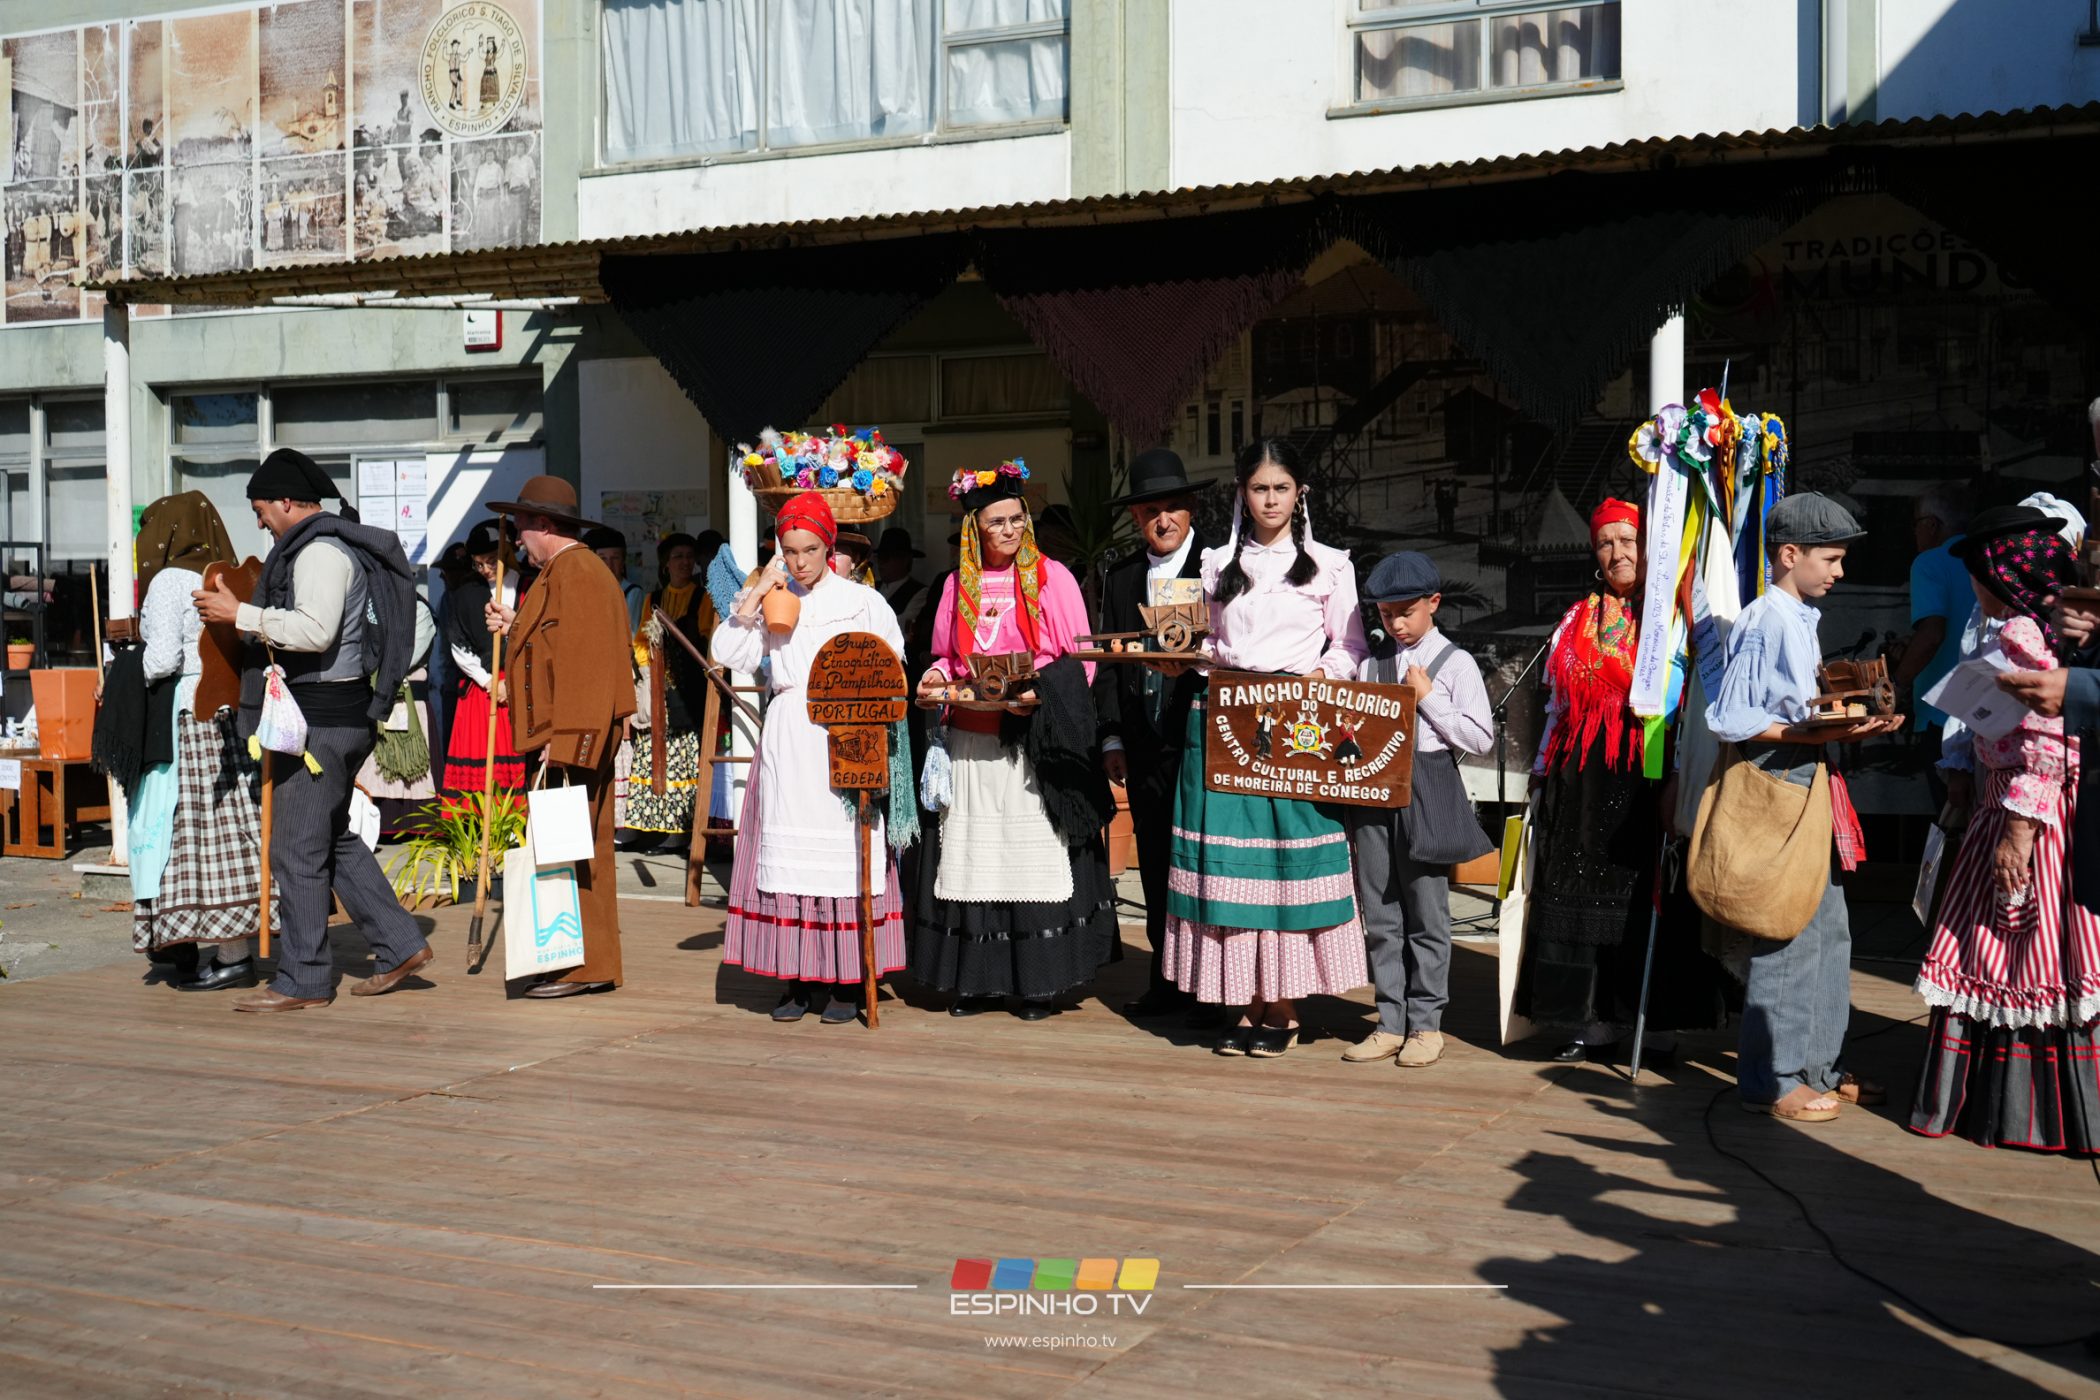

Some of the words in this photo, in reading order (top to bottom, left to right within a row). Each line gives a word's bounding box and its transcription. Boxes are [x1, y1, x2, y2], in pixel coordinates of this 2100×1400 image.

[480, 6, 488, 17] S.
[491, 9, 514, 37] TIAGO
[427, 7, 475, 58] FOLCLORICO
[512, 40, 521, 56] DE
[424, 64, 440, 113] RANCHO
[500, 63, 522, 115] SILVALDE
[448, 118, 492, 132] ESPINHO
[833, 632, 877, 657] Grupo
[820, 650, 892, 675] Etnográfico
[808, 672, 822, 690] de
[823, 670, 905, 696] Pampilhosa
[1219, 681, 1303, 707] RANCHO
[812, 703, 898, 720] PORTUGAL
[1301, 699, 1318, 712] DO
[1215, 715, 1250, 767] CENTRO
[1251, 761, 1321, 784] CULTURAL
[1328, 770, 1337, 784] E
[1345, 731, 1406, 783] RECREATIVO
[833, 771, 883, 785] GEDEPA
[1234, 775, 1292, 794] MOREIRA
[1296, 782, 1313, 795] DE
[1319, 782, 1391, 802] CÓNEGOS
[537, 946, 583, 963] ESPINHO
